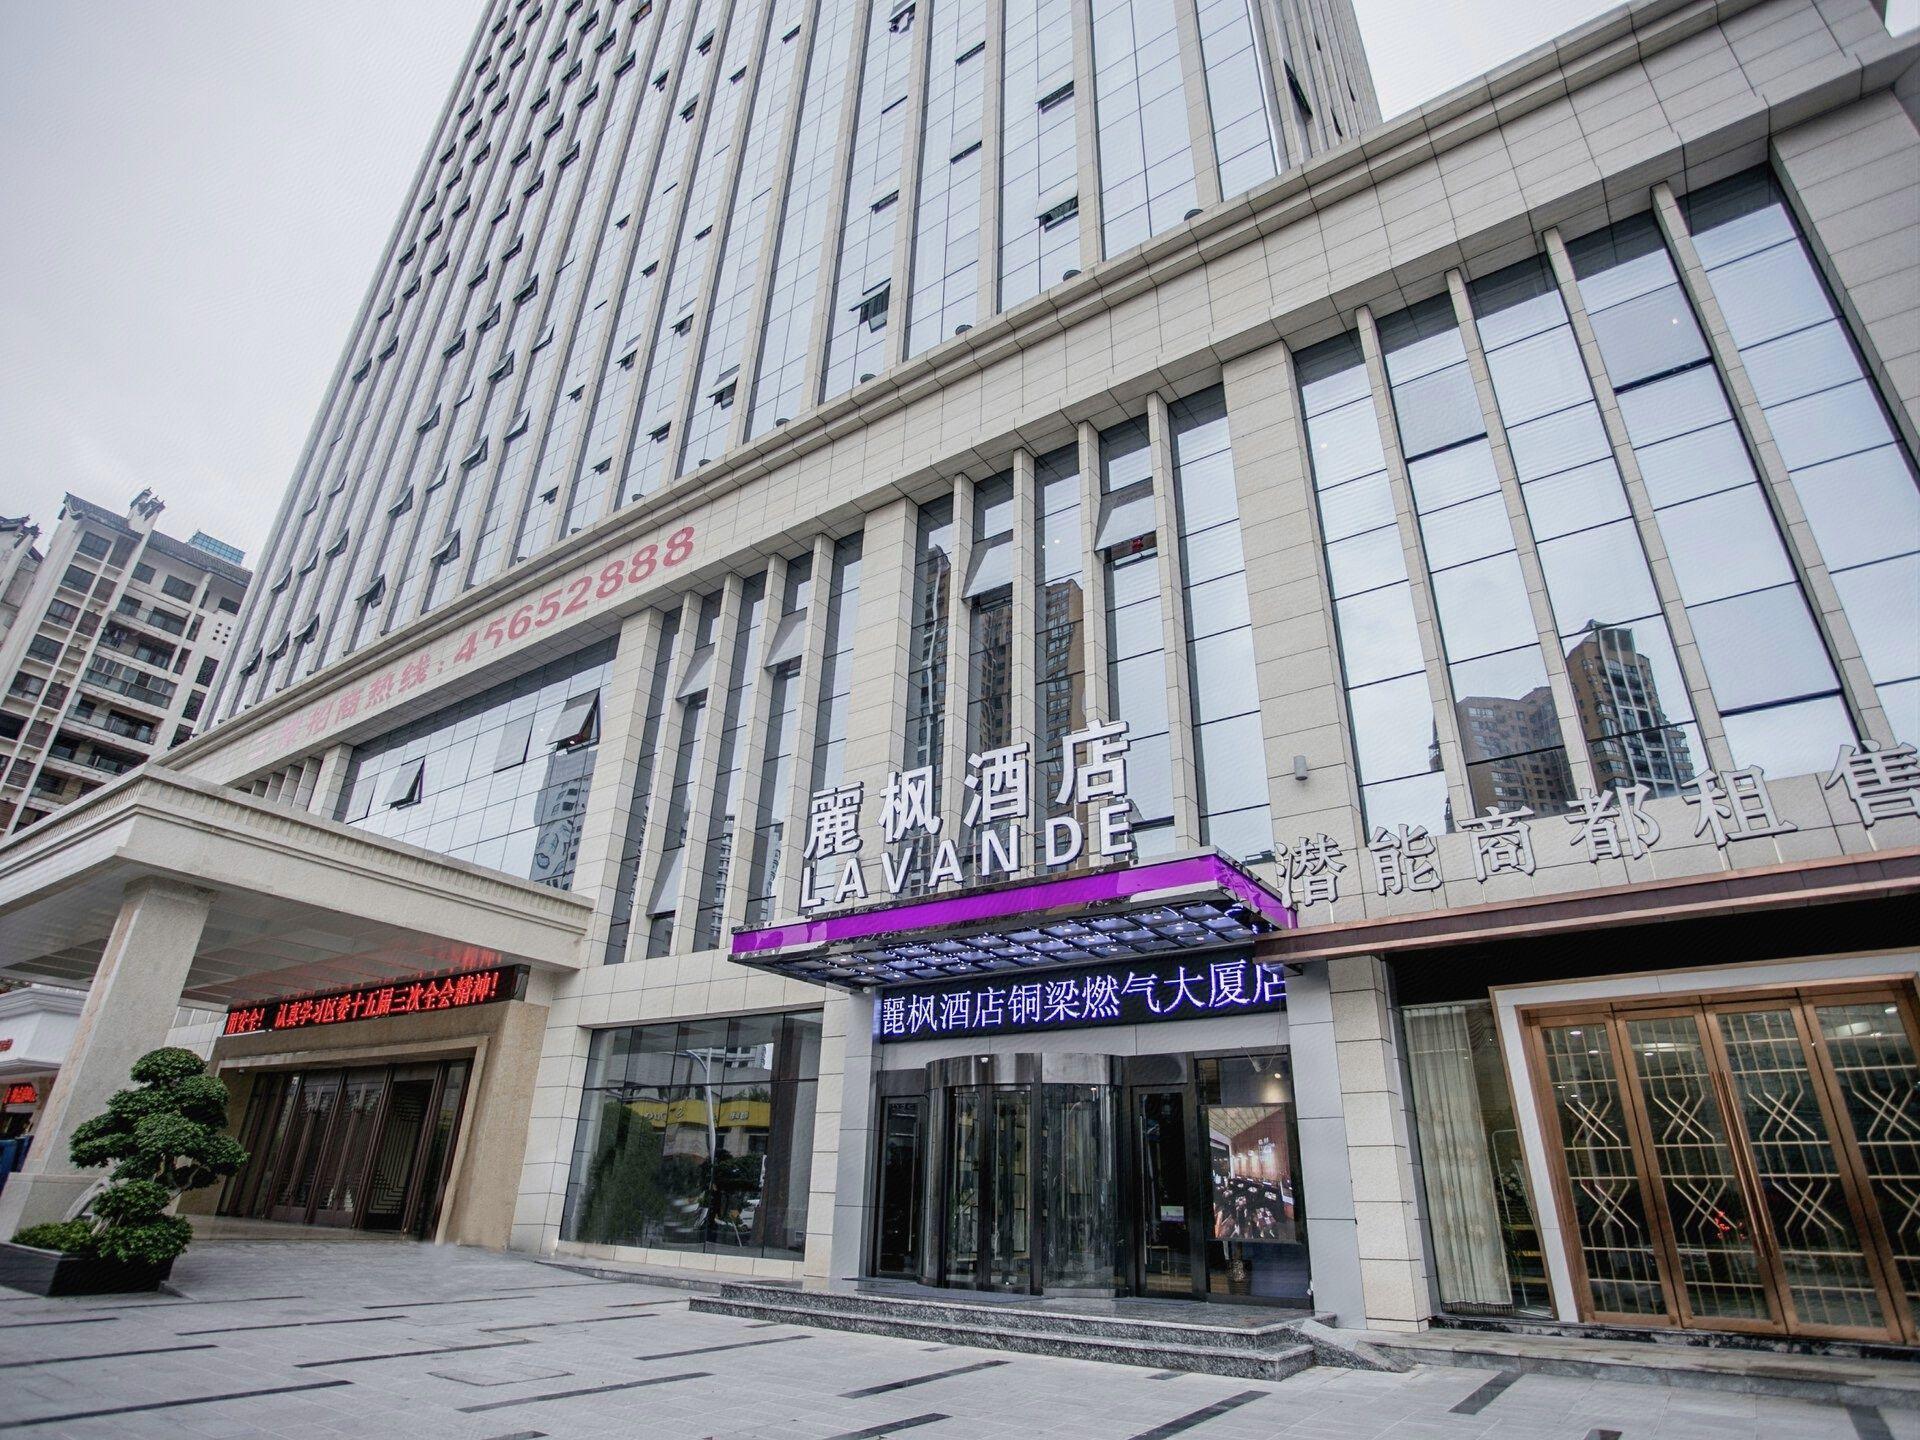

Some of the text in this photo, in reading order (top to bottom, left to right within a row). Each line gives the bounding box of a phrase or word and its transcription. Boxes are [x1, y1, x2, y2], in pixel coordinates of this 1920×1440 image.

[247, 526, 696, 764] 二招商热线:45652888
[799, 802, 1134, 909] LAVANDE
[804, 718, 1131, 860] 麗枫酒店
[1274, 740, 1920, 909] 潜能商都租售
[275, 972, 499, 1027] 认真学习区委十五届三次全会精神!
